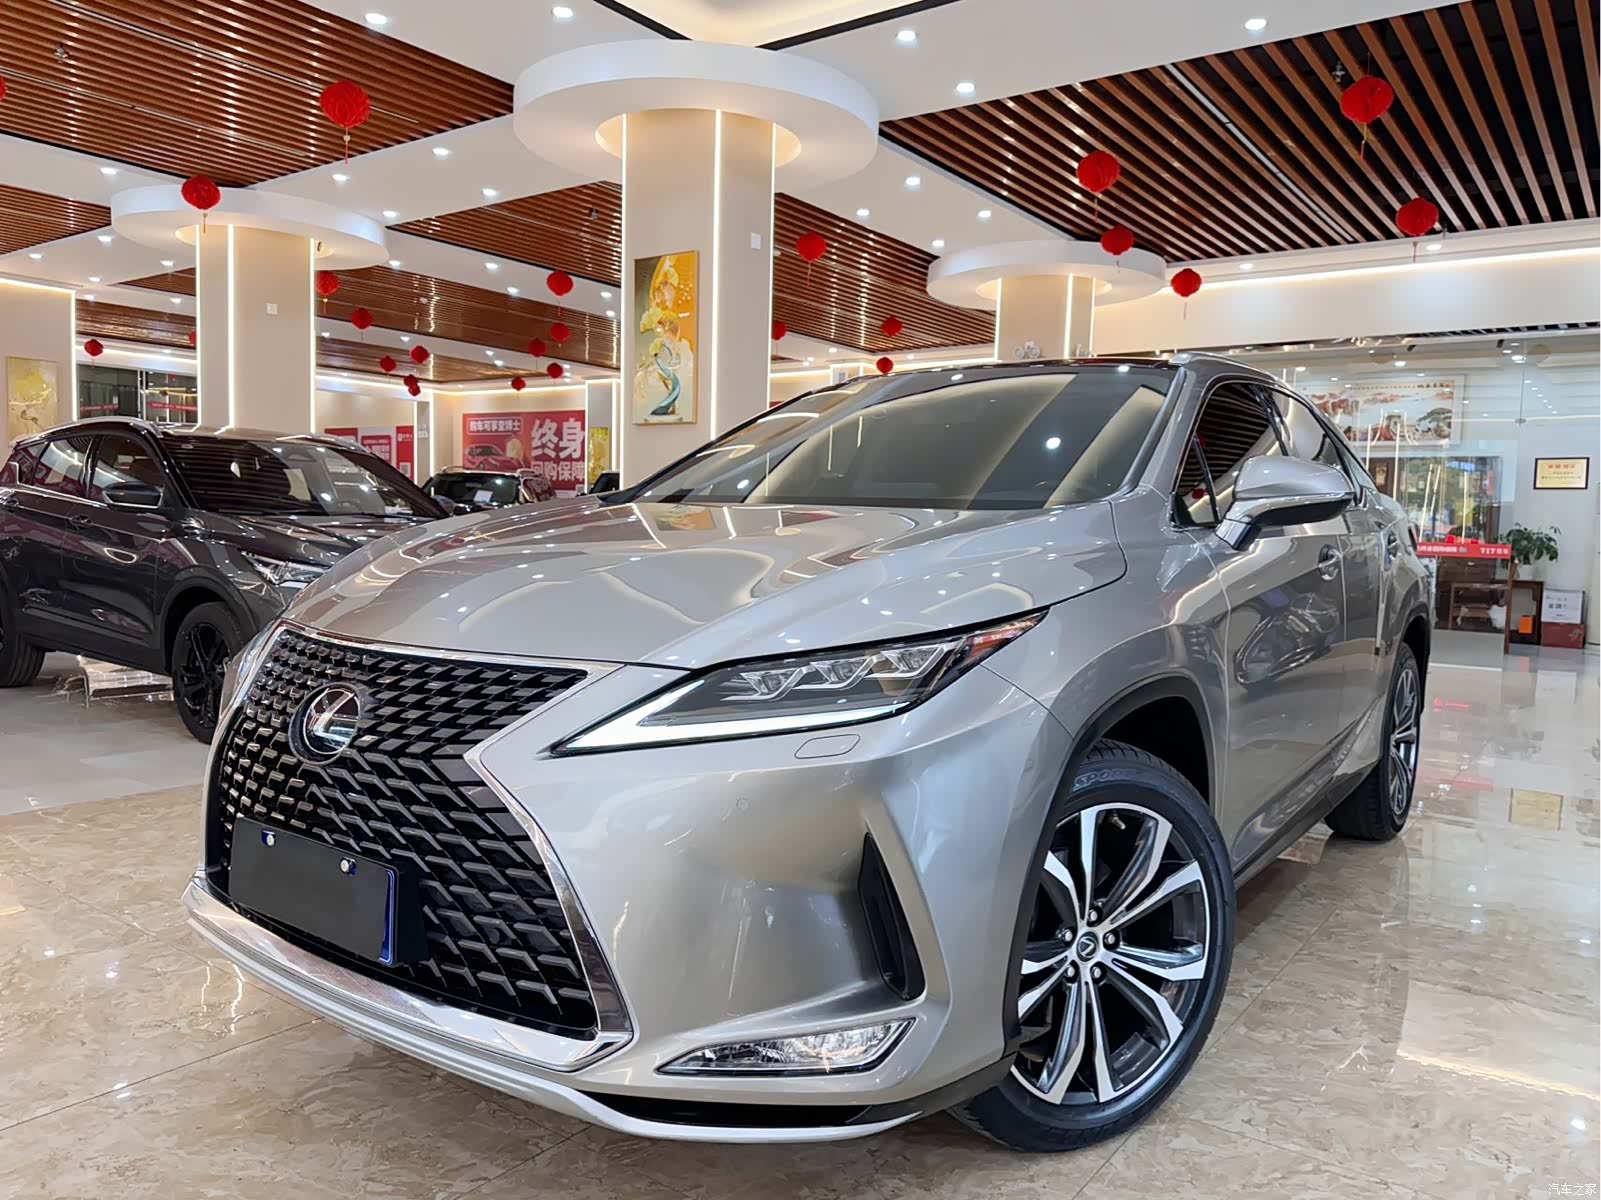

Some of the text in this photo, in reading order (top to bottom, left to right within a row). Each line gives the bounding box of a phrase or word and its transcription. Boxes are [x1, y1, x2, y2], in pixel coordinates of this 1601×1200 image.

[531, 418, 585, 459] 终身
[531, 461, 585, 481] 回购保障
